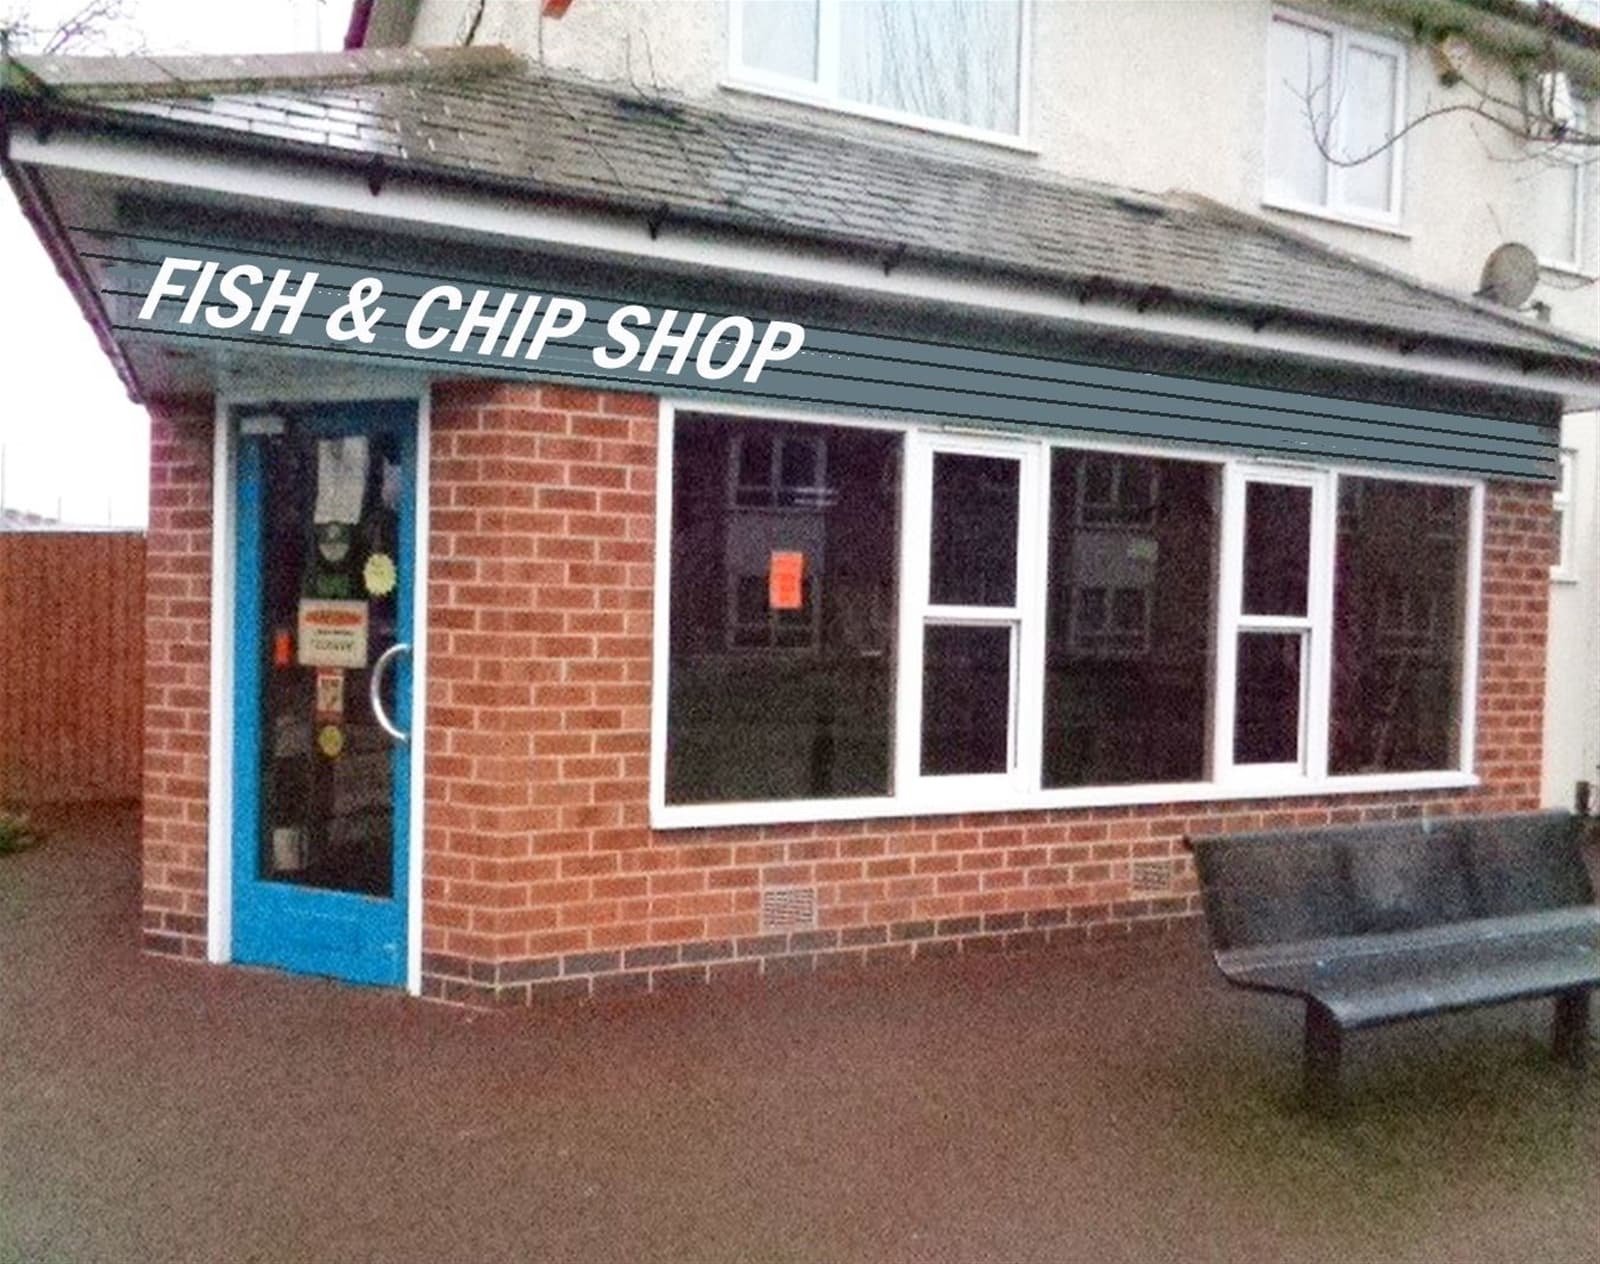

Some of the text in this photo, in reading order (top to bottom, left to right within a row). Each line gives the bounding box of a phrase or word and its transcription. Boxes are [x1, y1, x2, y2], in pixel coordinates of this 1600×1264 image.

[138, 257, 806, 383] FISH & CHIP SHOP
